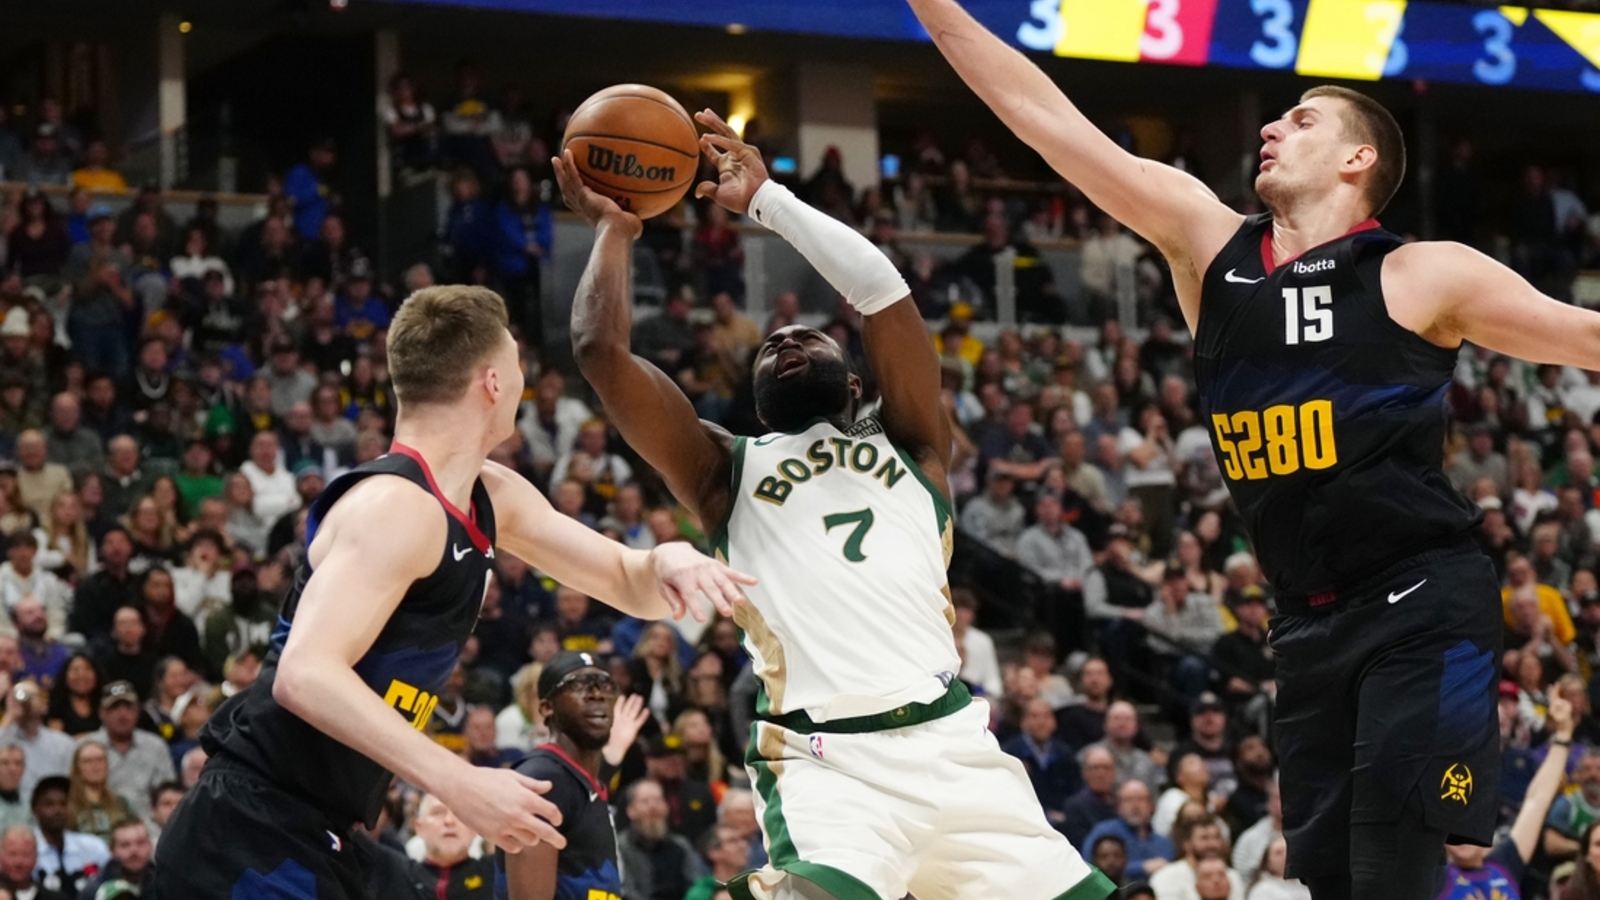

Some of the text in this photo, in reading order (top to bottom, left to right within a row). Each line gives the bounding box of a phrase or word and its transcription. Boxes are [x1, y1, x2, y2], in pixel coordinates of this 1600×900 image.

[1138, 0, 1183, 59] 3
[1250, 0, 1297, 68] 3
[1472, 10, 1516, 85] 3
[587, 143, 676, 181] Wilson
[1293, 259, 1336, 274] ibotta
[1282, 285, 1334, 345] 15
[1211, 399, 1338, 480] 5280
[752, 436, 907, 506] BOSTON
[822, 507, 874, 563] 7
